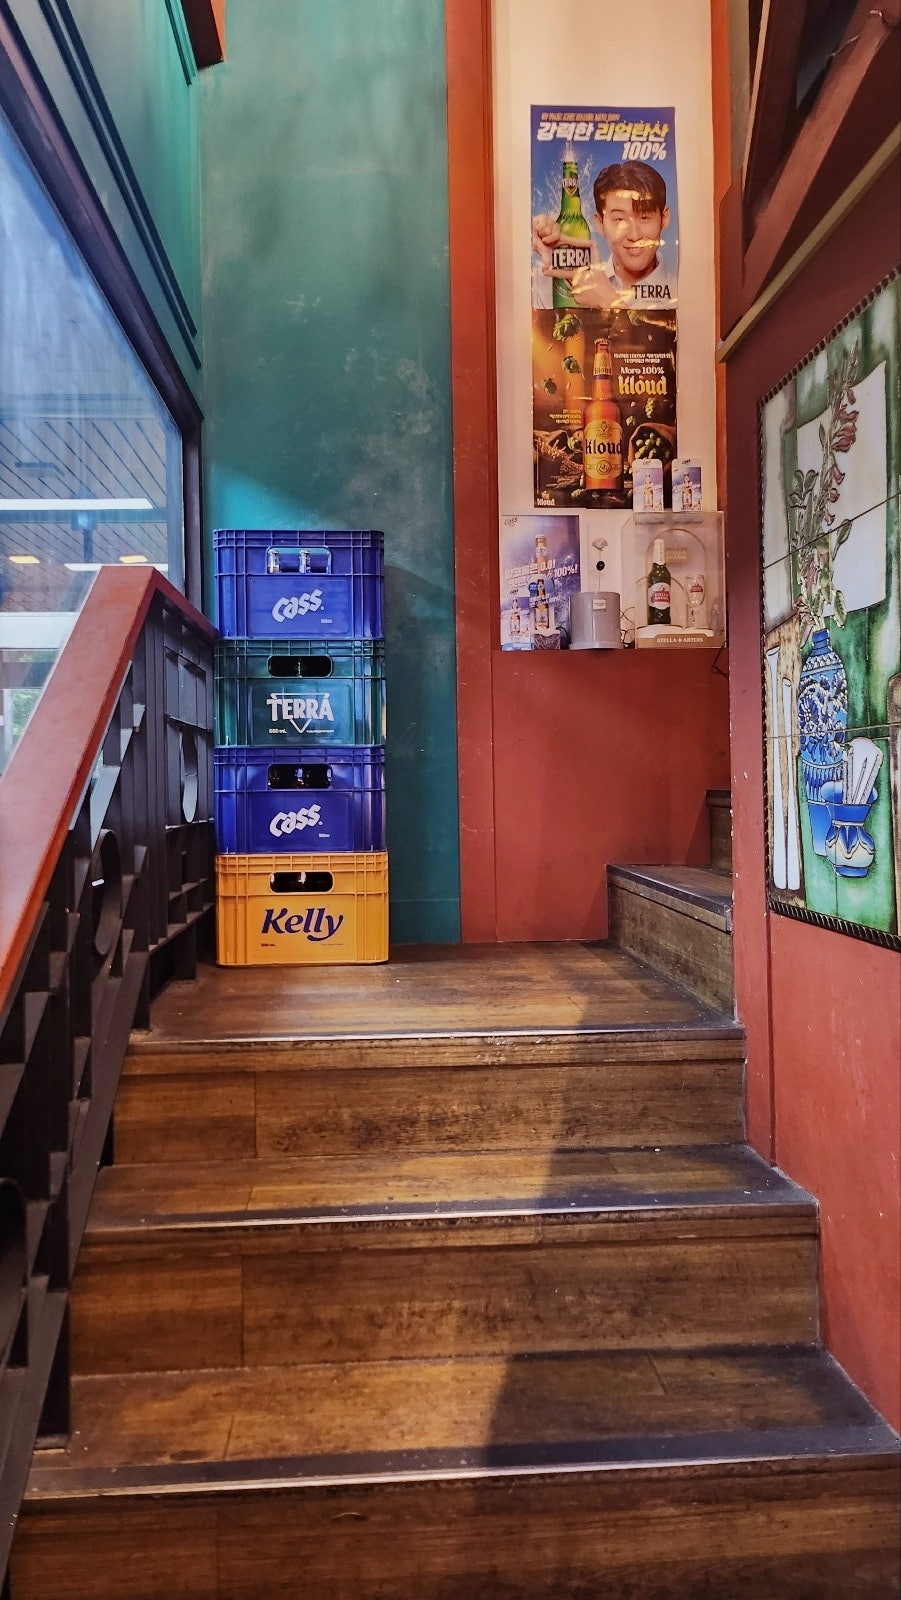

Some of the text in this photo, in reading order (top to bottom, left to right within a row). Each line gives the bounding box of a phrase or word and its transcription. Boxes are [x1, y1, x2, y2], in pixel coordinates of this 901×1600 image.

[537, 121, 669, 142] 강력한 리얼탄산
[621, 141, 667, 160] 100%
[552, 248, 590, 268] TERRA
[631, 285, 671, 299] TERRA
[620, 366, 664, 375] More 100%
[554, 564, 578, 578] 100%!
[266, 699, 334, 721] TERRA
[261, 907, 344, 941] Kelly
